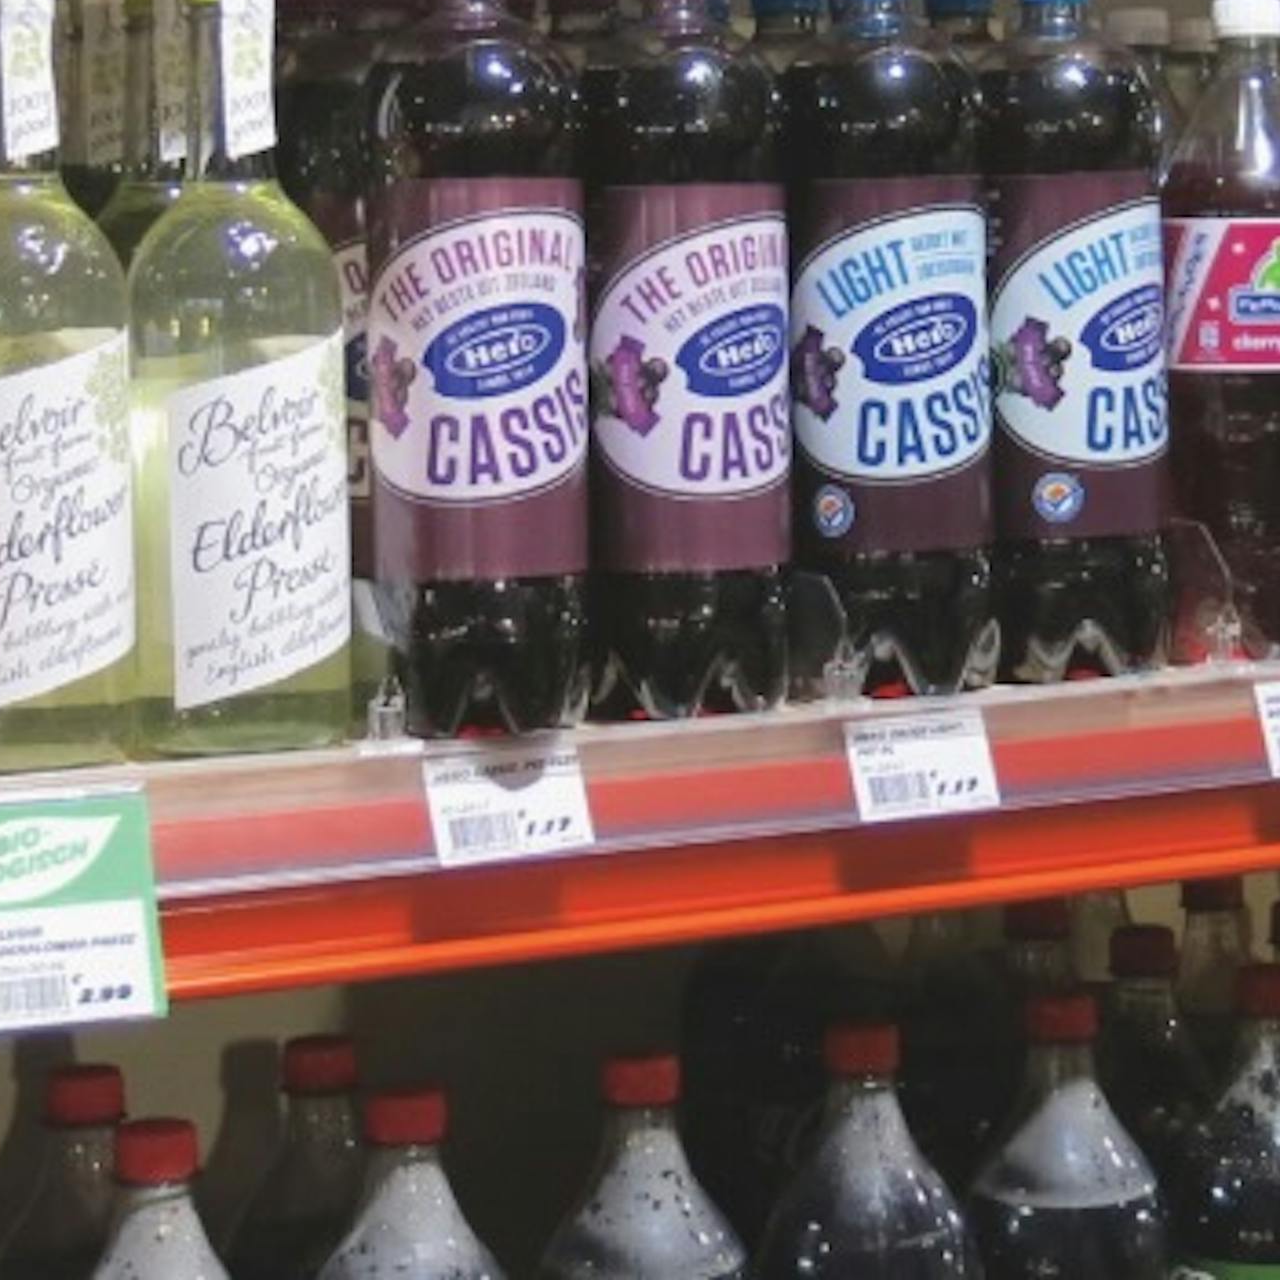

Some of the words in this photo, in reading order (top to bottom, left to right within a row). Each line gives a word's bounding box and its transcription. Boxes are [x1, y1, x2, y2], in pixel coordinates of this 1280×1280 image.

[381, 261, 431, 322] THE
[430, 228, 573, 286] ORIGINAL
[619, 264, 683, 326] THE
[816, 238, 911, 320] LIGHT
[1039, 229, 1129, 311] LIGHT
[463, 328, 537, 370] Hero
[716, 330, 774, 369] Hero
[890, 320, 955, 357] Hero
[177, 385, 319, 478] Belvoir
[78, 984, 133, 1005] 2.99
